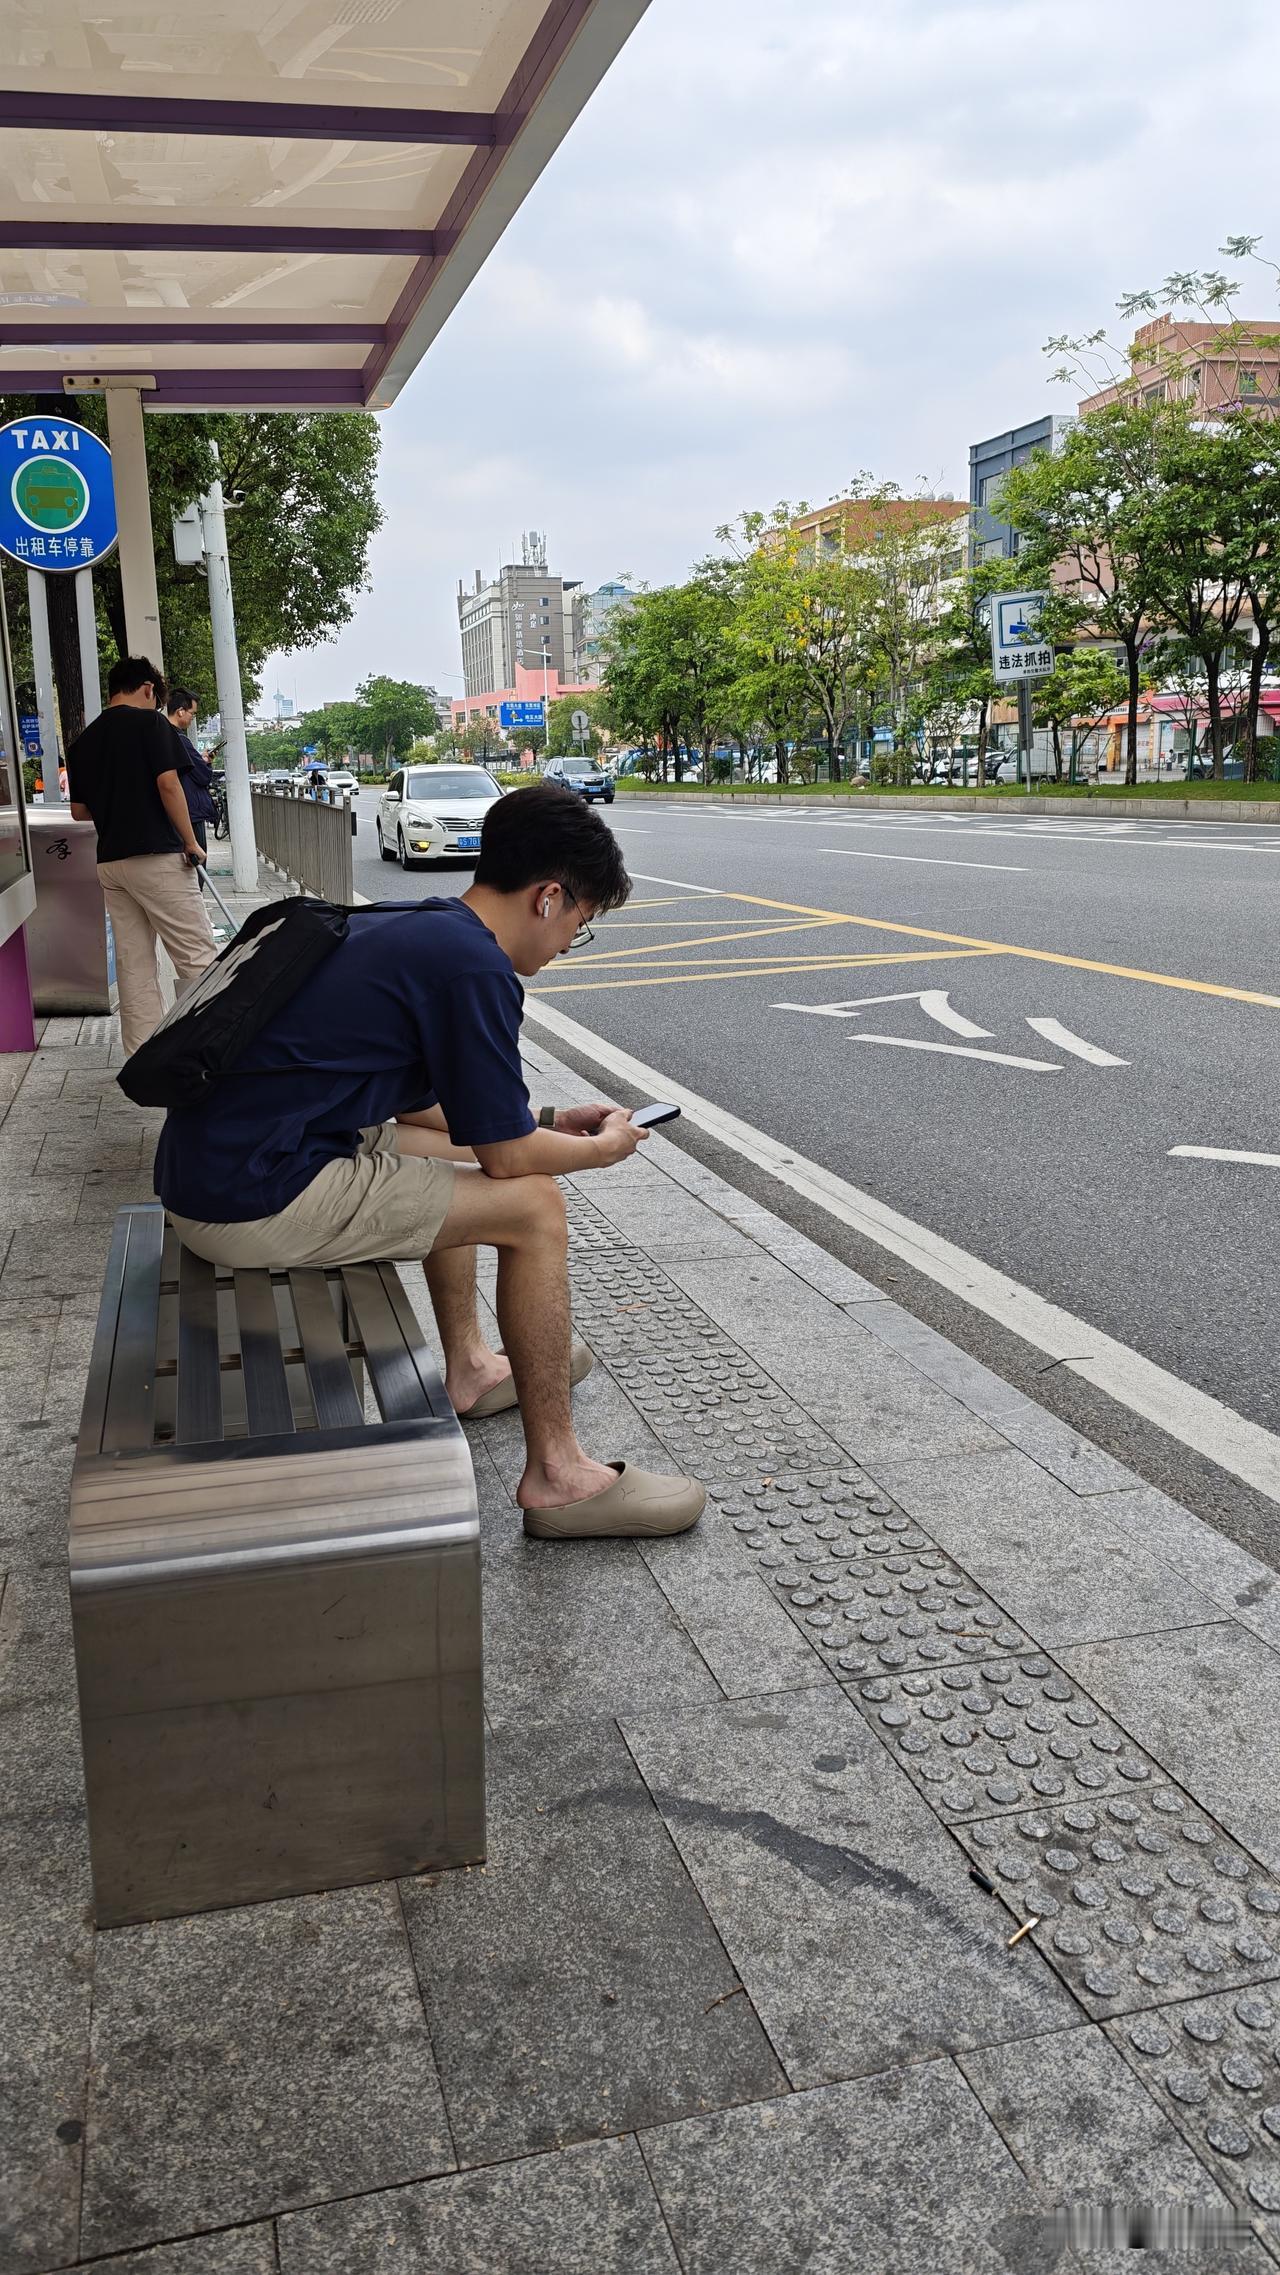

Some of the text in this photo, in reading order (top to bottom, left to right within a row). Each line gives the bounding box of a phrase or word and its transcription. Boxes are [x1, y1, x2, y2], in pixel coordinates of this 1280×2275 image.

[11, 429, 80, 451] TAXI
[15, 536, 95, 558] 出租车停靠
[999, 649, 1051, 670] 违法抓拍
